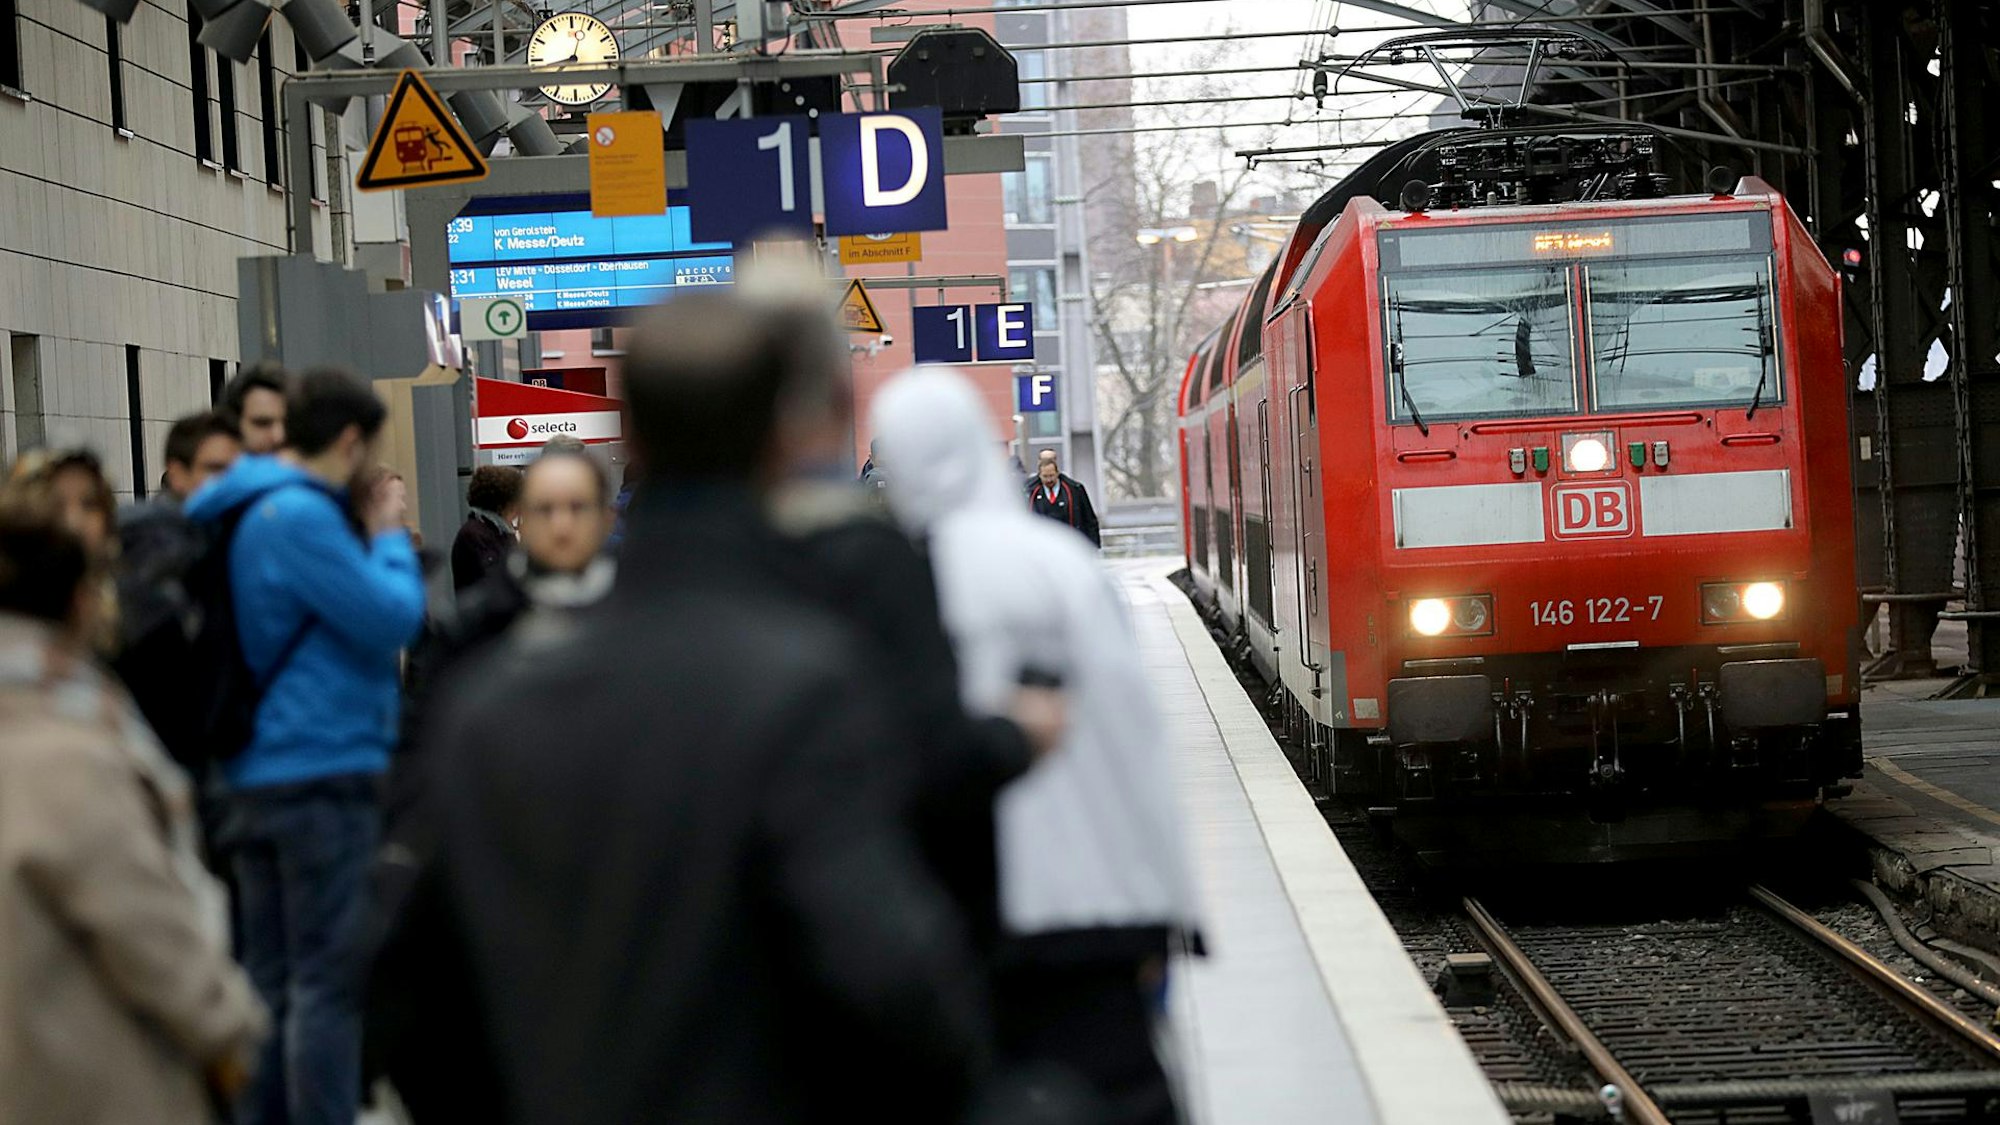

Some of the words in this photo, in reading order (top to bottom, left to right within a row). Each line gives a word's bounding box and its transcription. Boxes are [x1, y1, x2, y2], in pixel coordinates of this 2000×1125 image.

[757, 122, 795, 212] 1
[859, 114, 929, 208] D
[494, 228, 510, 237] von
[512, 225, 556, 236] Gerolstein
[495, 238, 503, 250] K
[507, 234, 585, 250] Messe/Deutz
[848, 249, 859, 258] im
[862, 247, 903, 258] Abschnitt
[905, 246, 911, 255] F
[496, 267, 511, 277] LEV
[598, 261, 649, 272] Oberhausen
[497, 276, 534, 289] Wesel
[946, 308, 965, 349] 1
[997, 304, 1027, 348] E
[1031, 374, 1053, 406] F
[531, 421, 577, 434] selecta
[1562, 491, 1623, 530] DB
[1530, 600, 1574, 626] 146
[1585, 595, 1664, 624] 122-7
